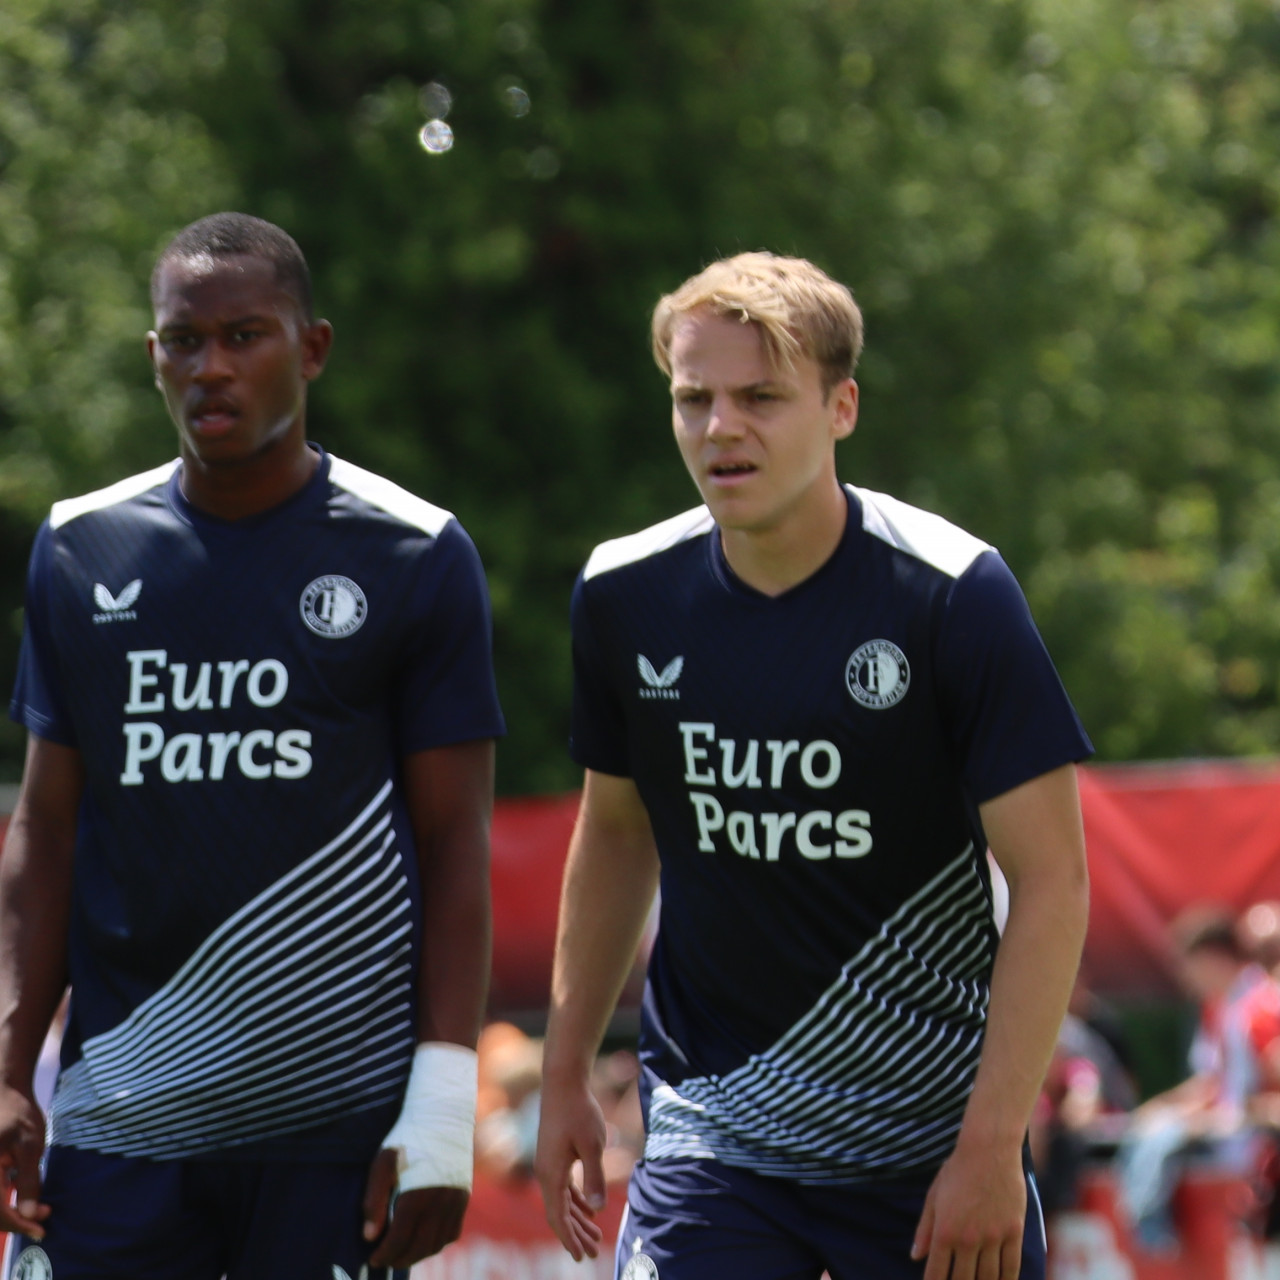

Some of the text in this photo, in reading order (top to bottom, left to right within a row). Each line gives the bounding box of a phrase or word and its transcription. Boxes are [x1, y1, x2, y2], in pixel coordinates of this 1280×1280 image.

[124, 649, 289, 714] Euro
[120, 722, 313, 786] Parcs
[678, 721, 842, 789] Euro
[689, 791, 874, 862] Parcs
